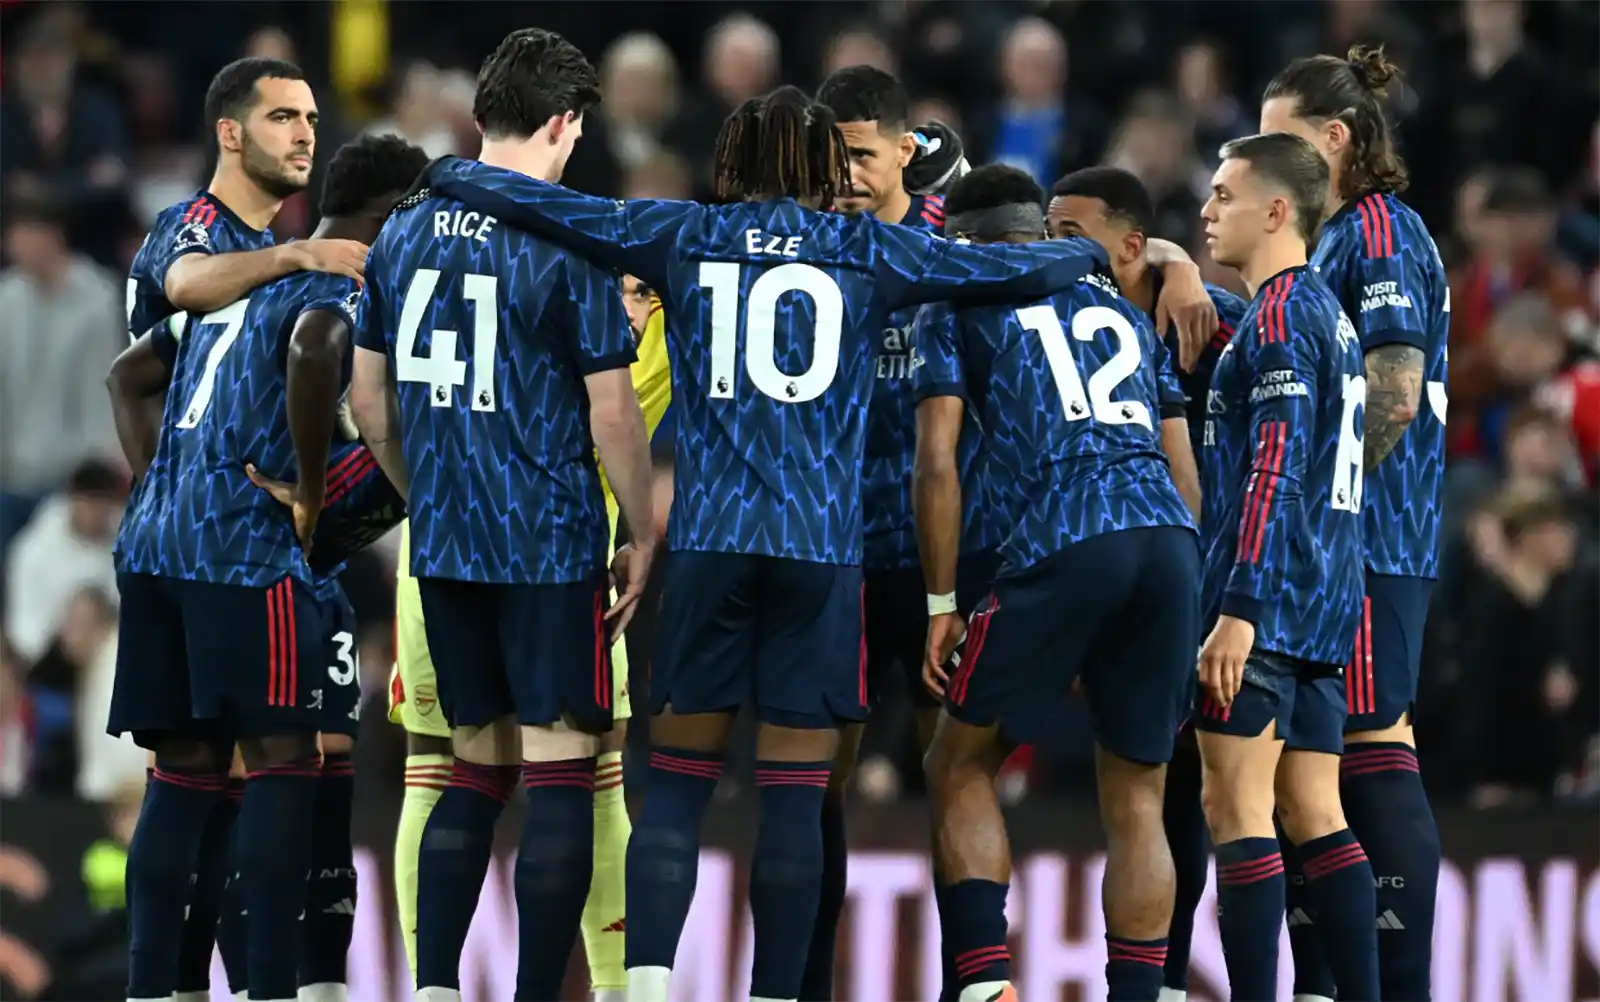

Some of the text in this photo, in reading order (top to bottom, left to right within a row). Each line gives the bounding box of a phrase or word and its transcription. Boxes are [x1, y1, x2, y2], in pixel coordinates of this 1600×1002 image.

[434, 210, 498, 243] RICE
[745, 228, 803, 258] EZE
[1360, 293, 1412, 313] WANDA
[1363, 281, 1397, 297] VISIT
[396, 268, 498, 412] 41
[699, 261, 844, 403] 10
[175, 298, 251, 429] 7
[1016, 305, 1153, 432] 12
[1261, 369, 1293, 384] VISIT
[328, 631, 361, 687] 3
